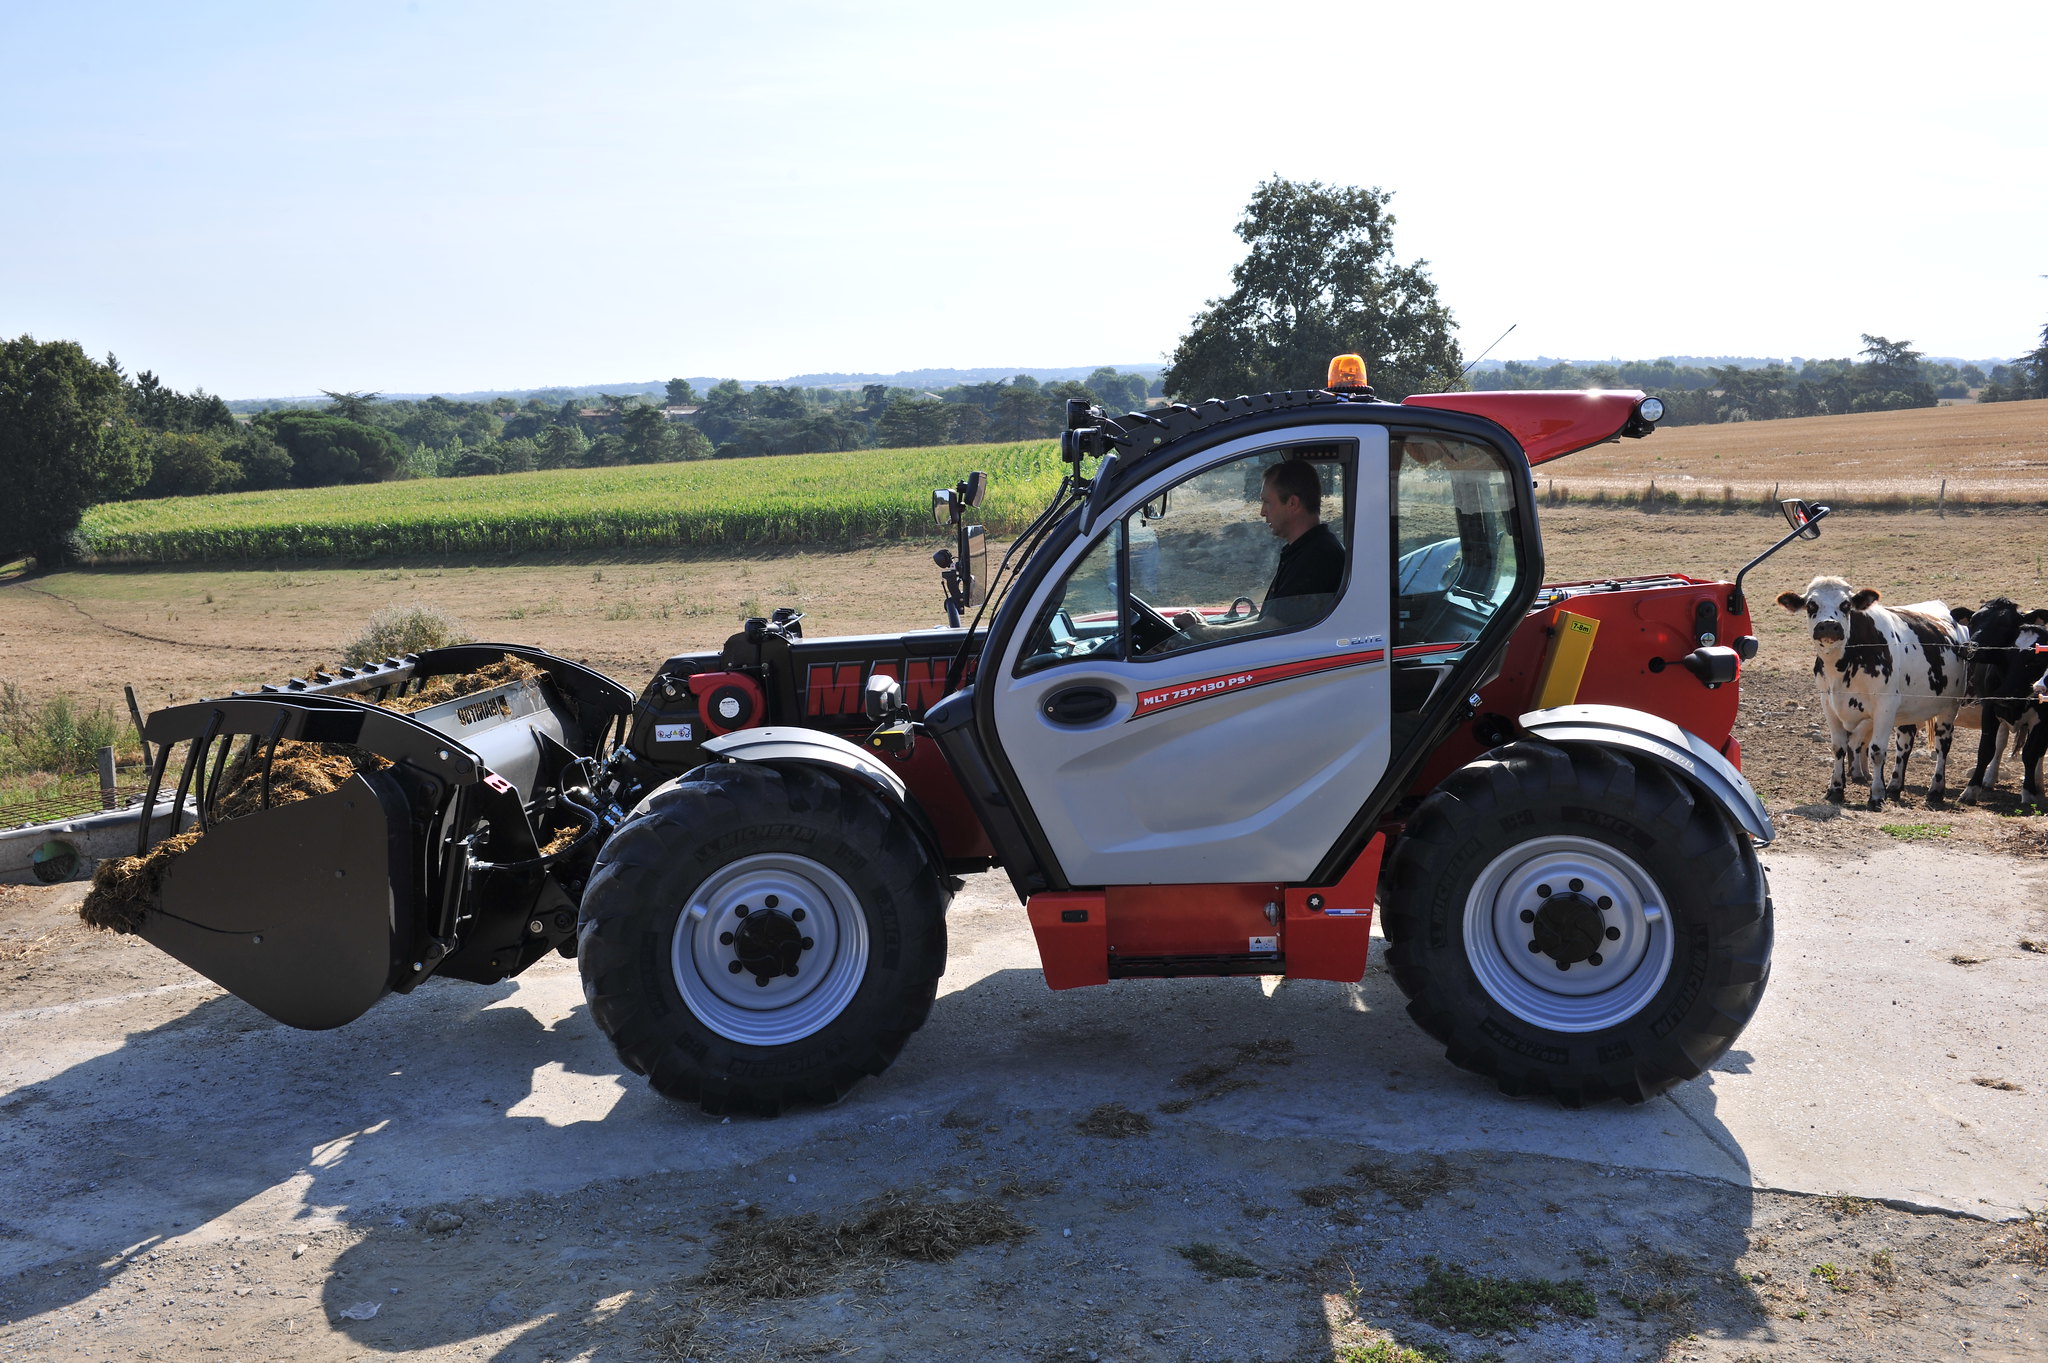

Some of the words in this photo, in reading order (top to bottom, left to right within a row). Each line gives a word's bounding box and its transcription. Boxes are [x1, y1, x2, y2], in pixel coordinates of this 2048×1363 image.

[1351, 634, 1382, 645] ELITE
[1573, 622, 1589, 632] 7-8m
[1143, 693, 1169, 706] MLT
[1172, 680, 1226, 699] 737-130
[1228, 674, 1253, 686] PS+
[717, 823, 815, 847] MICHELIN
[1430, 838, 1480, 923] MICHELIN
[1655, 951, 1709, 1039] MICHELIN
